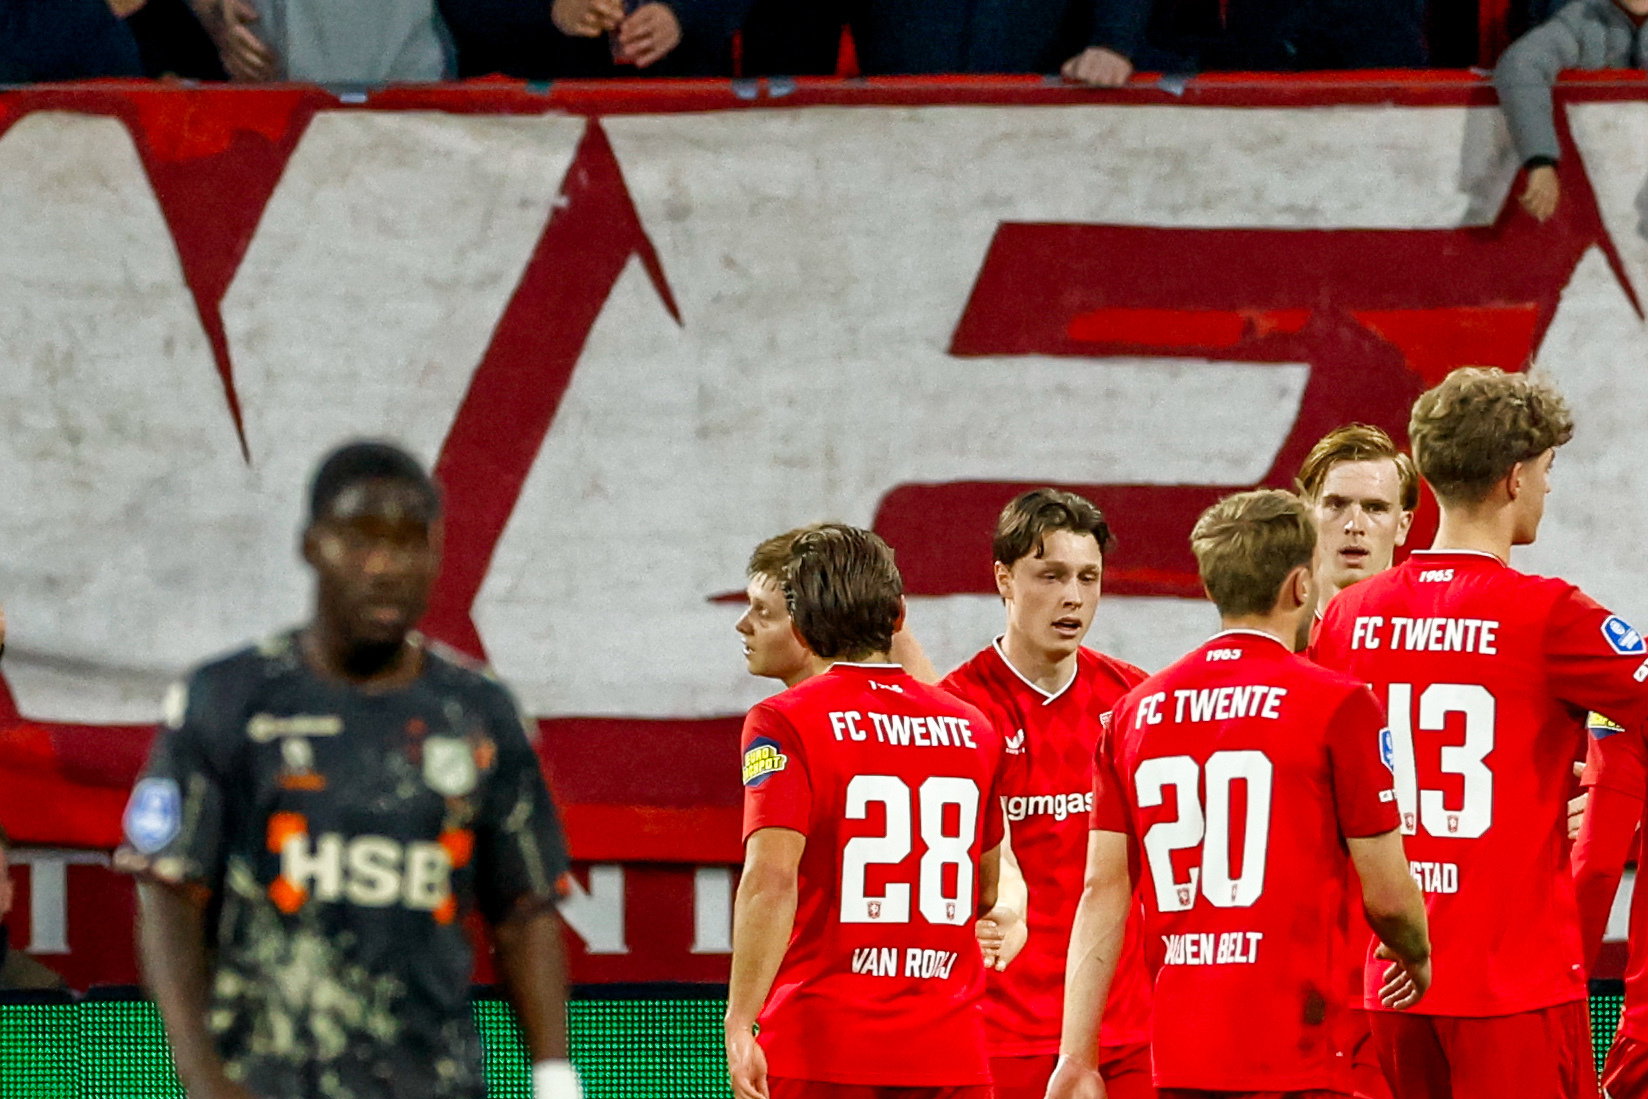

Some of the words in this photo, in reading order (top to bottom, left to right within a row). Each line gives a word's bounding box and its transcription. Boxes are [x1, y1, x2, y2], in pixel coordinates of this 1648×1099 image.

[1418, 568, 1455, 583] 1965
[1351, 615, 1384, 650] FC
[1390, 616, 1500, 655] TWENTE
[1205, 648, 1243, 662] 1965
[1134, 691, 1167, 730] FC
[1173, 684, 1288, 723] TWENTE
[828, 711, 867, 742] FC
[867, 711, 977, 749] TWENTE
[840, 774, 981, 927] 28
[1134, 749, 1274, 914] 20
[279, 830, 453, 912] HSB
[851, 947, 899, 978] VAN
[1216, 931, 1264, 965] BELT
